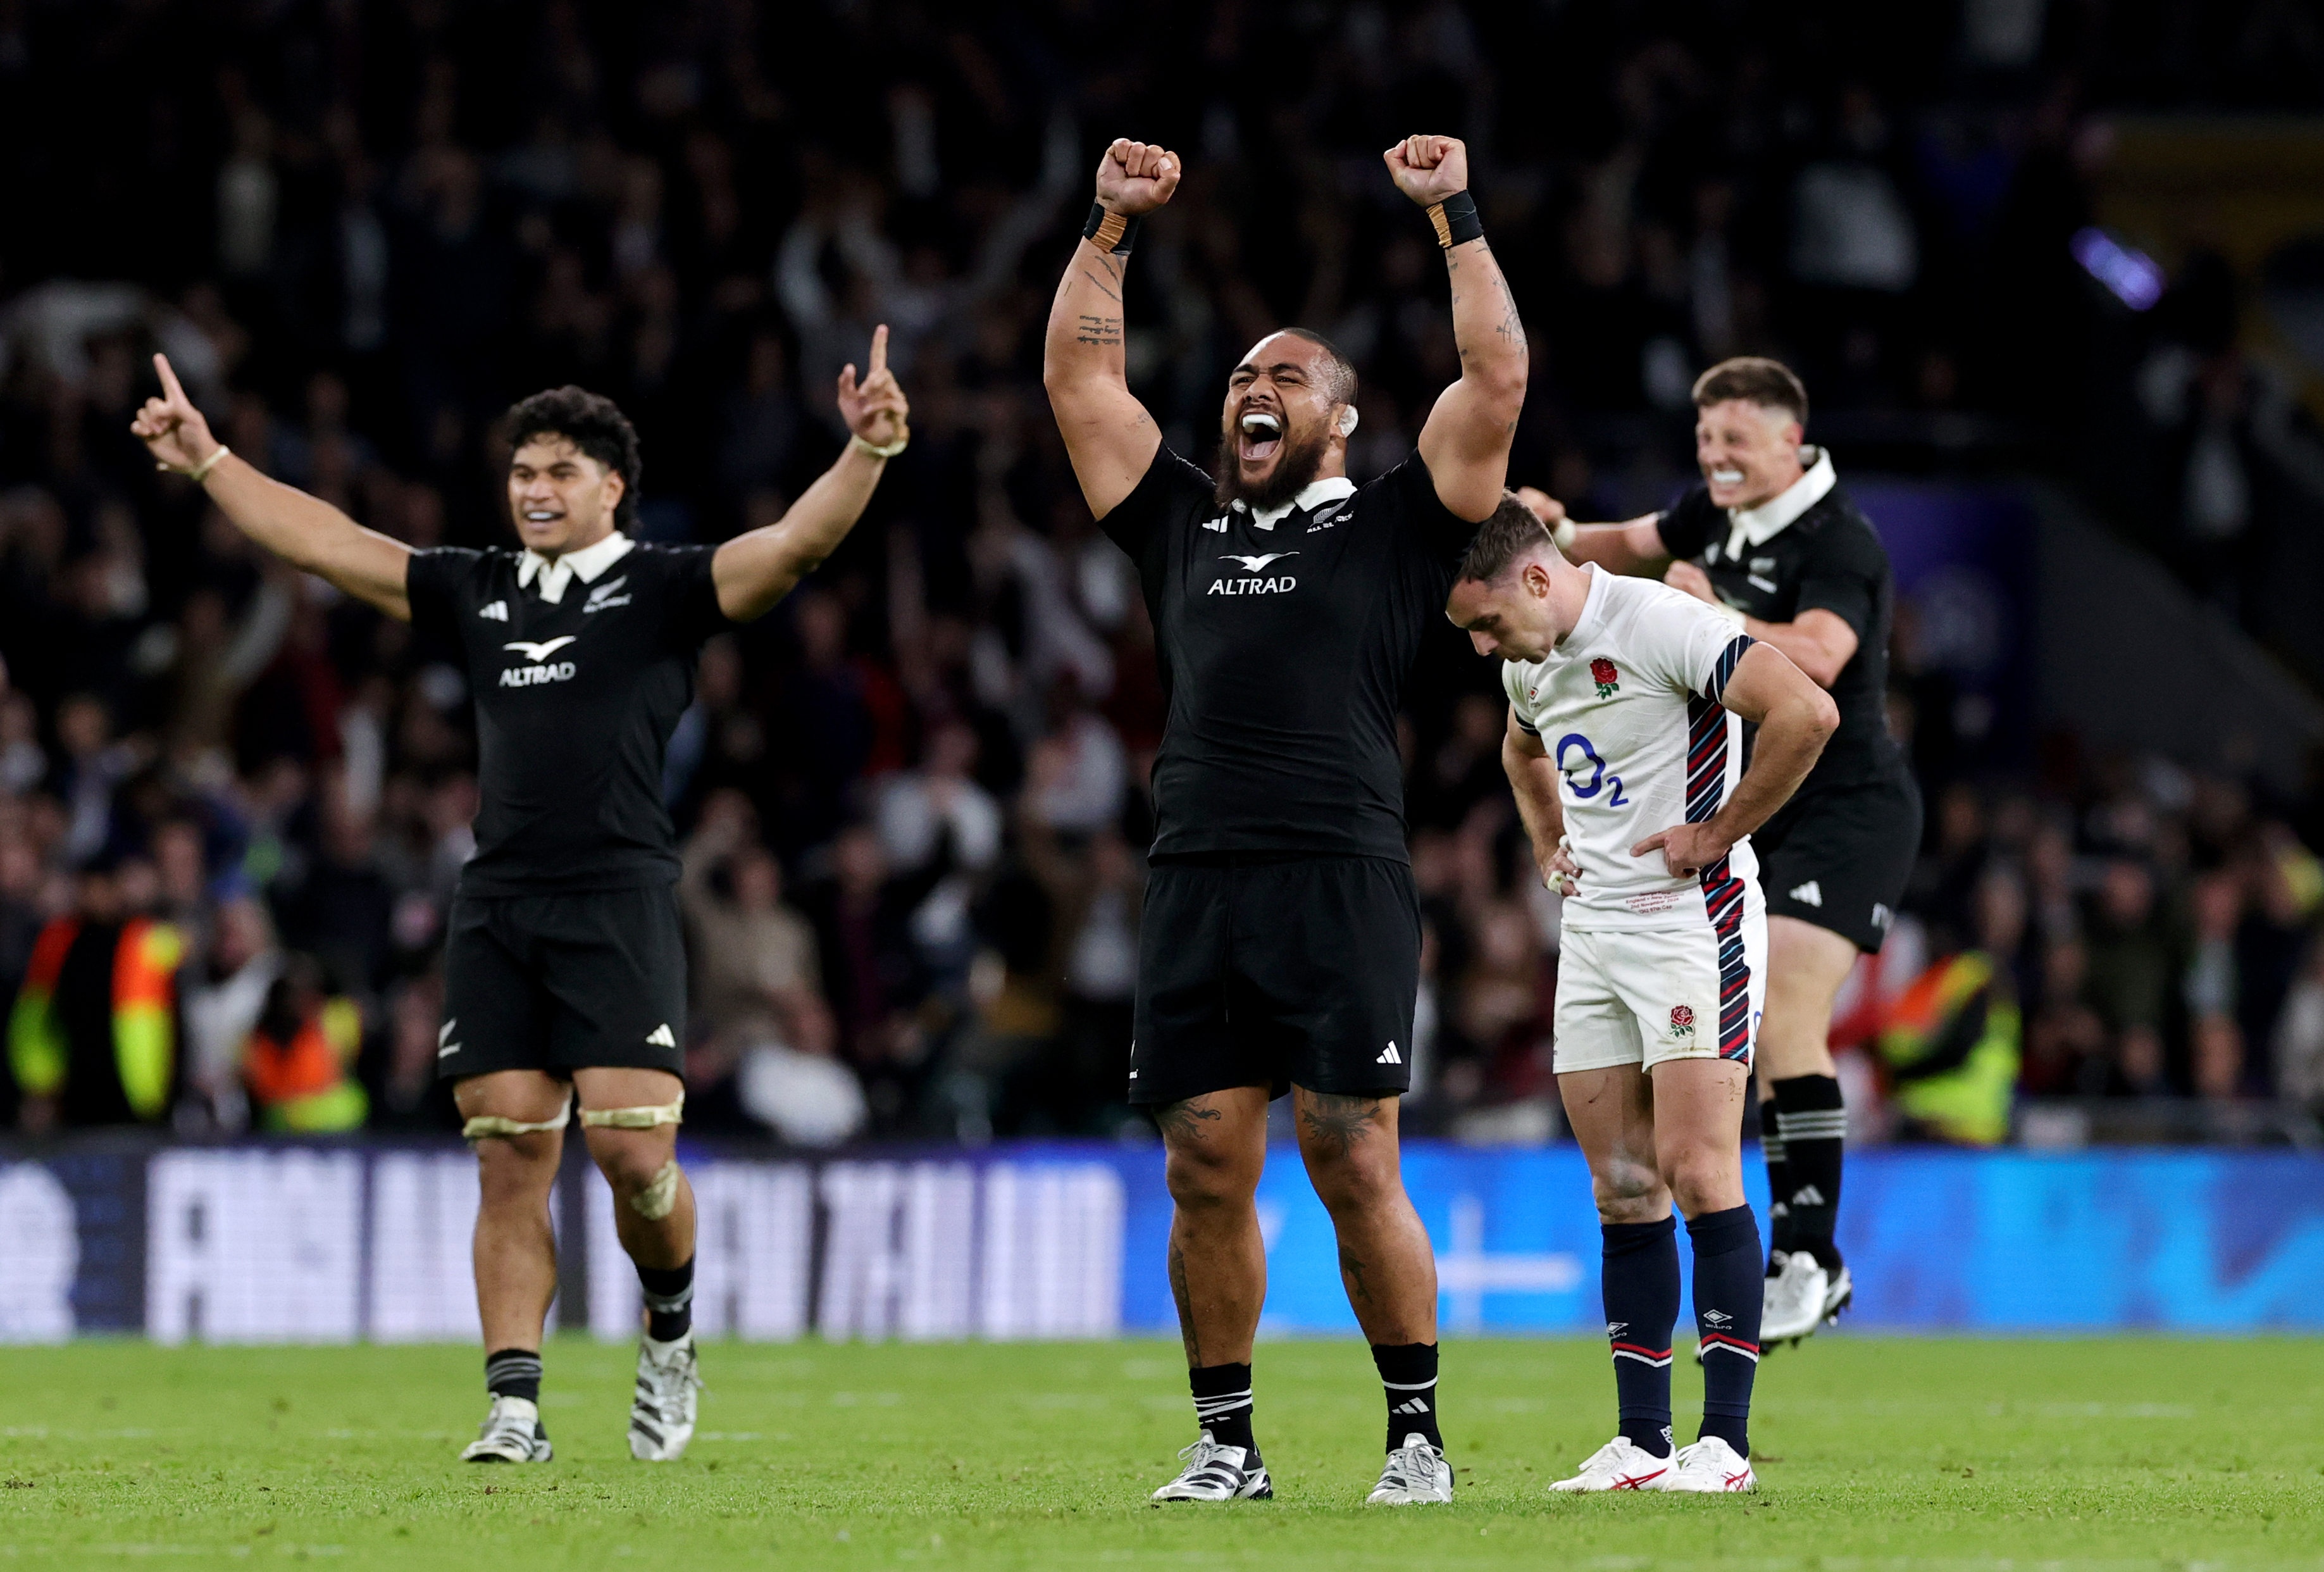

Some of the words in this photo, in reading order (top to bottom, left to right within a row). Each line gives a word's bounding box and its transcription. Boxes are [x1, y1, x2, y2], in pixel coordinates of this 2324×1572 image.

[1307, 525, 1322, 533] ALL
[1322, 513, 1353, 528] BLCKS
[1207, 576, 1296, 596] ALTRAD
[499, 661, 576, 687] ALTRAD
[1557, 733, 1629, 808] O2
